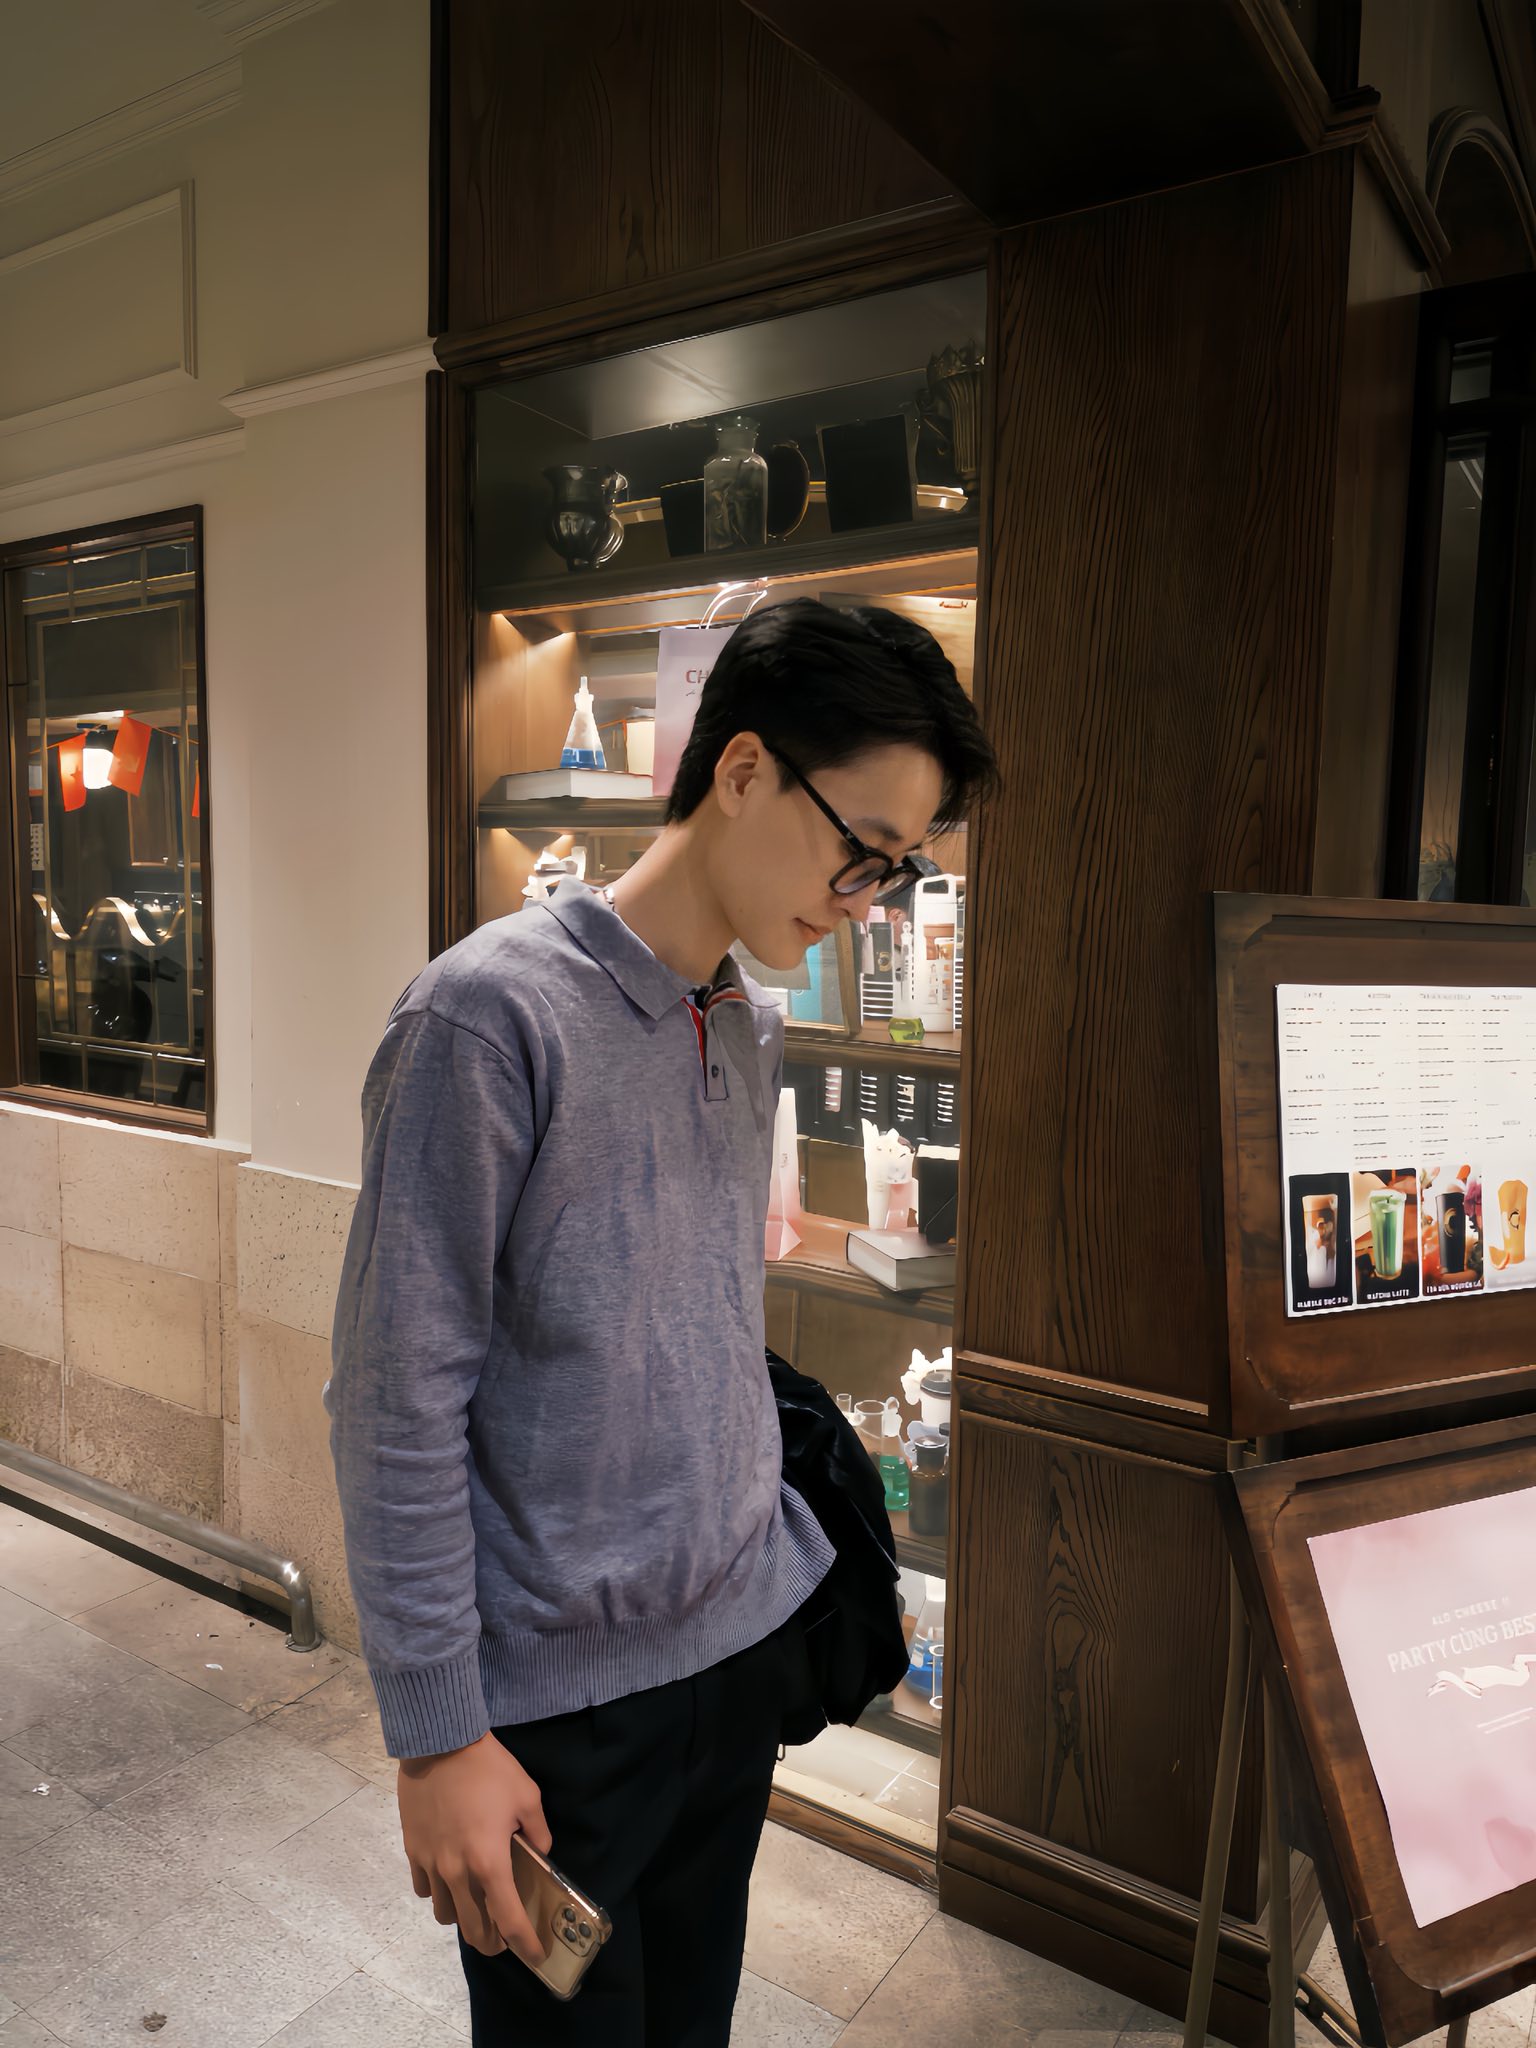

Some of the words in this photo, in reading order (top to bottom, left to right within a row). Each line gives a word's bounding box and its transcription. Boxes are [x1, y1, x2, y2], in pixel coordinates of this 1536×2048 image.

[1387, 1639, 1447, 1673] PARTY
[1450, 1626, 1498, 1654] CÙNG
[1500, 1612, 1536, 1640] BES
